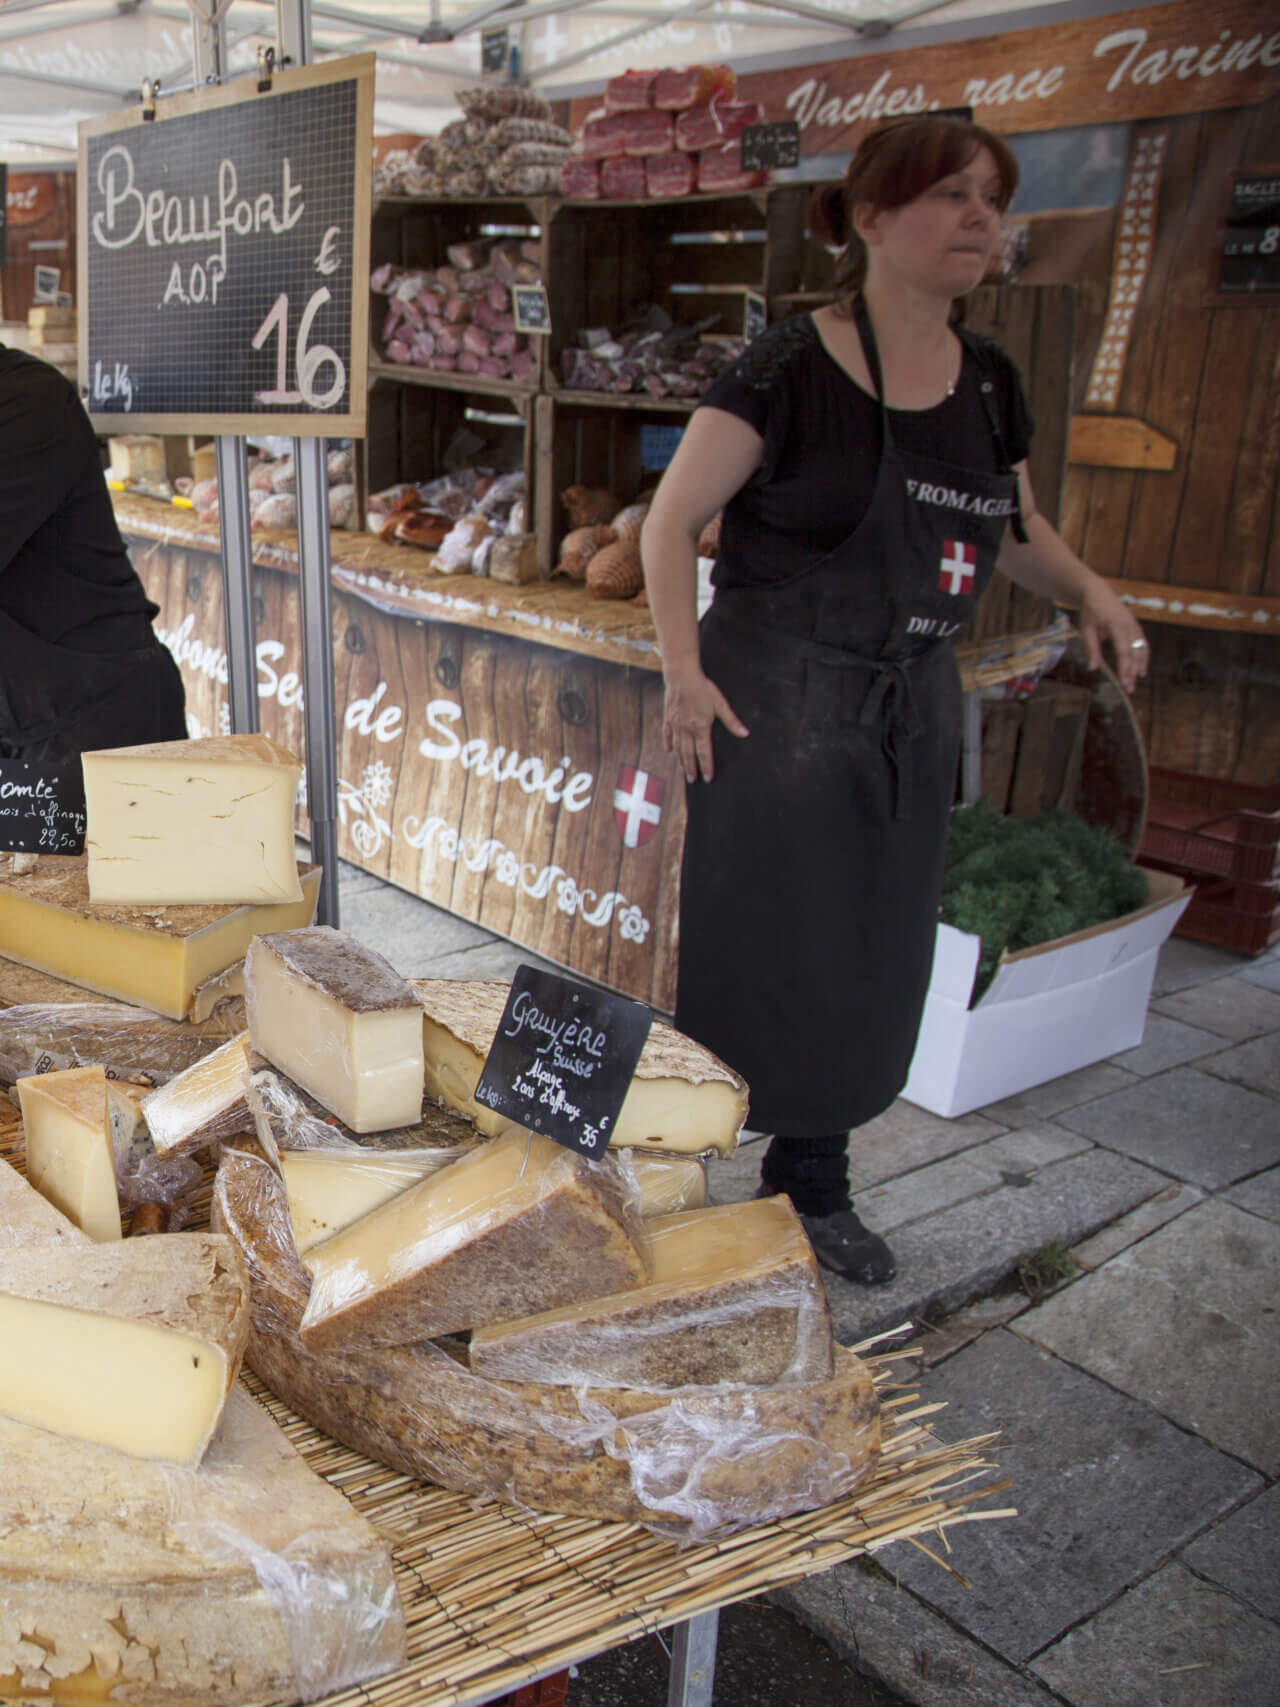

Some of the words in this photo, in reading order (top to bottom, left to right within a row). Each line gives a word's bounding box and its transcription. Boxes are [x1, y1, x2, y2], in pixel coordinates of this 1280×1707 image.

[965, 66, 1065, 109] race
[251, 285, 347, 410] 16
[906, 615, 937, 634] DU
[344, 681, 402, 742] de
[419, 699, 593, 812] Savoie
[578, 1122, 600, 1149] 35
